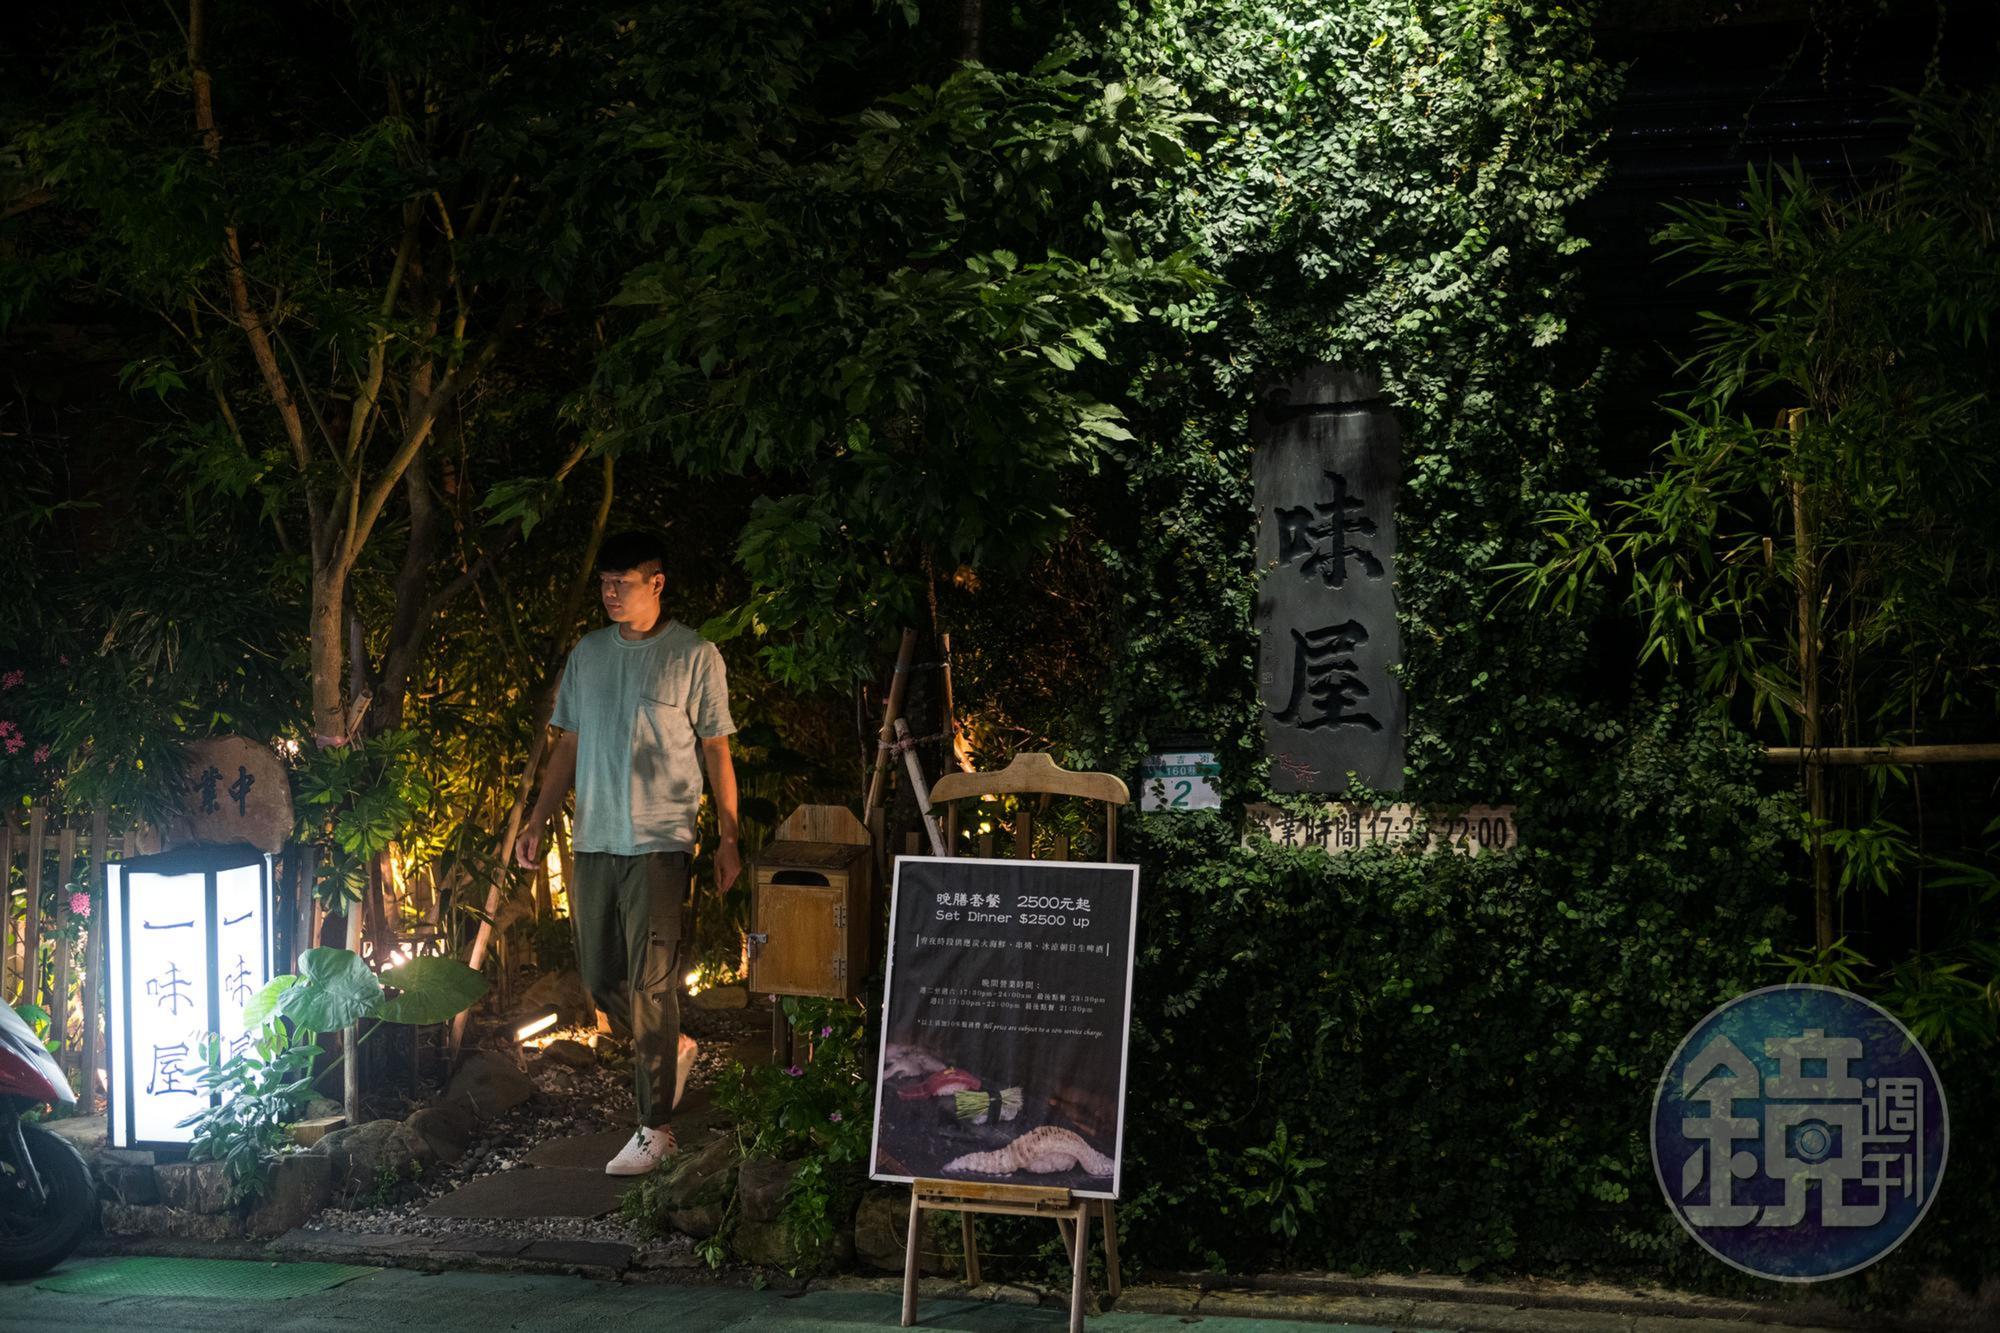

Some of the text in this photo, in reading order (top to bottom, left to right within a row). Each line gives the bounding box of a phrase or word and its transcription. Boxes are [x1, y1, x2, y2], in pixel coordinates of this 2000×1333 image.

[1264, 389, 1390, 733] 一味屋
[1170, 780, 1192, 807] 2
[936, 892, 1091, 912] 晚膳套餐 2500元起
[935, 909, 1090, 928] Set Dinner $2500 up
[143, 919, 198, 1097] 一味屋
